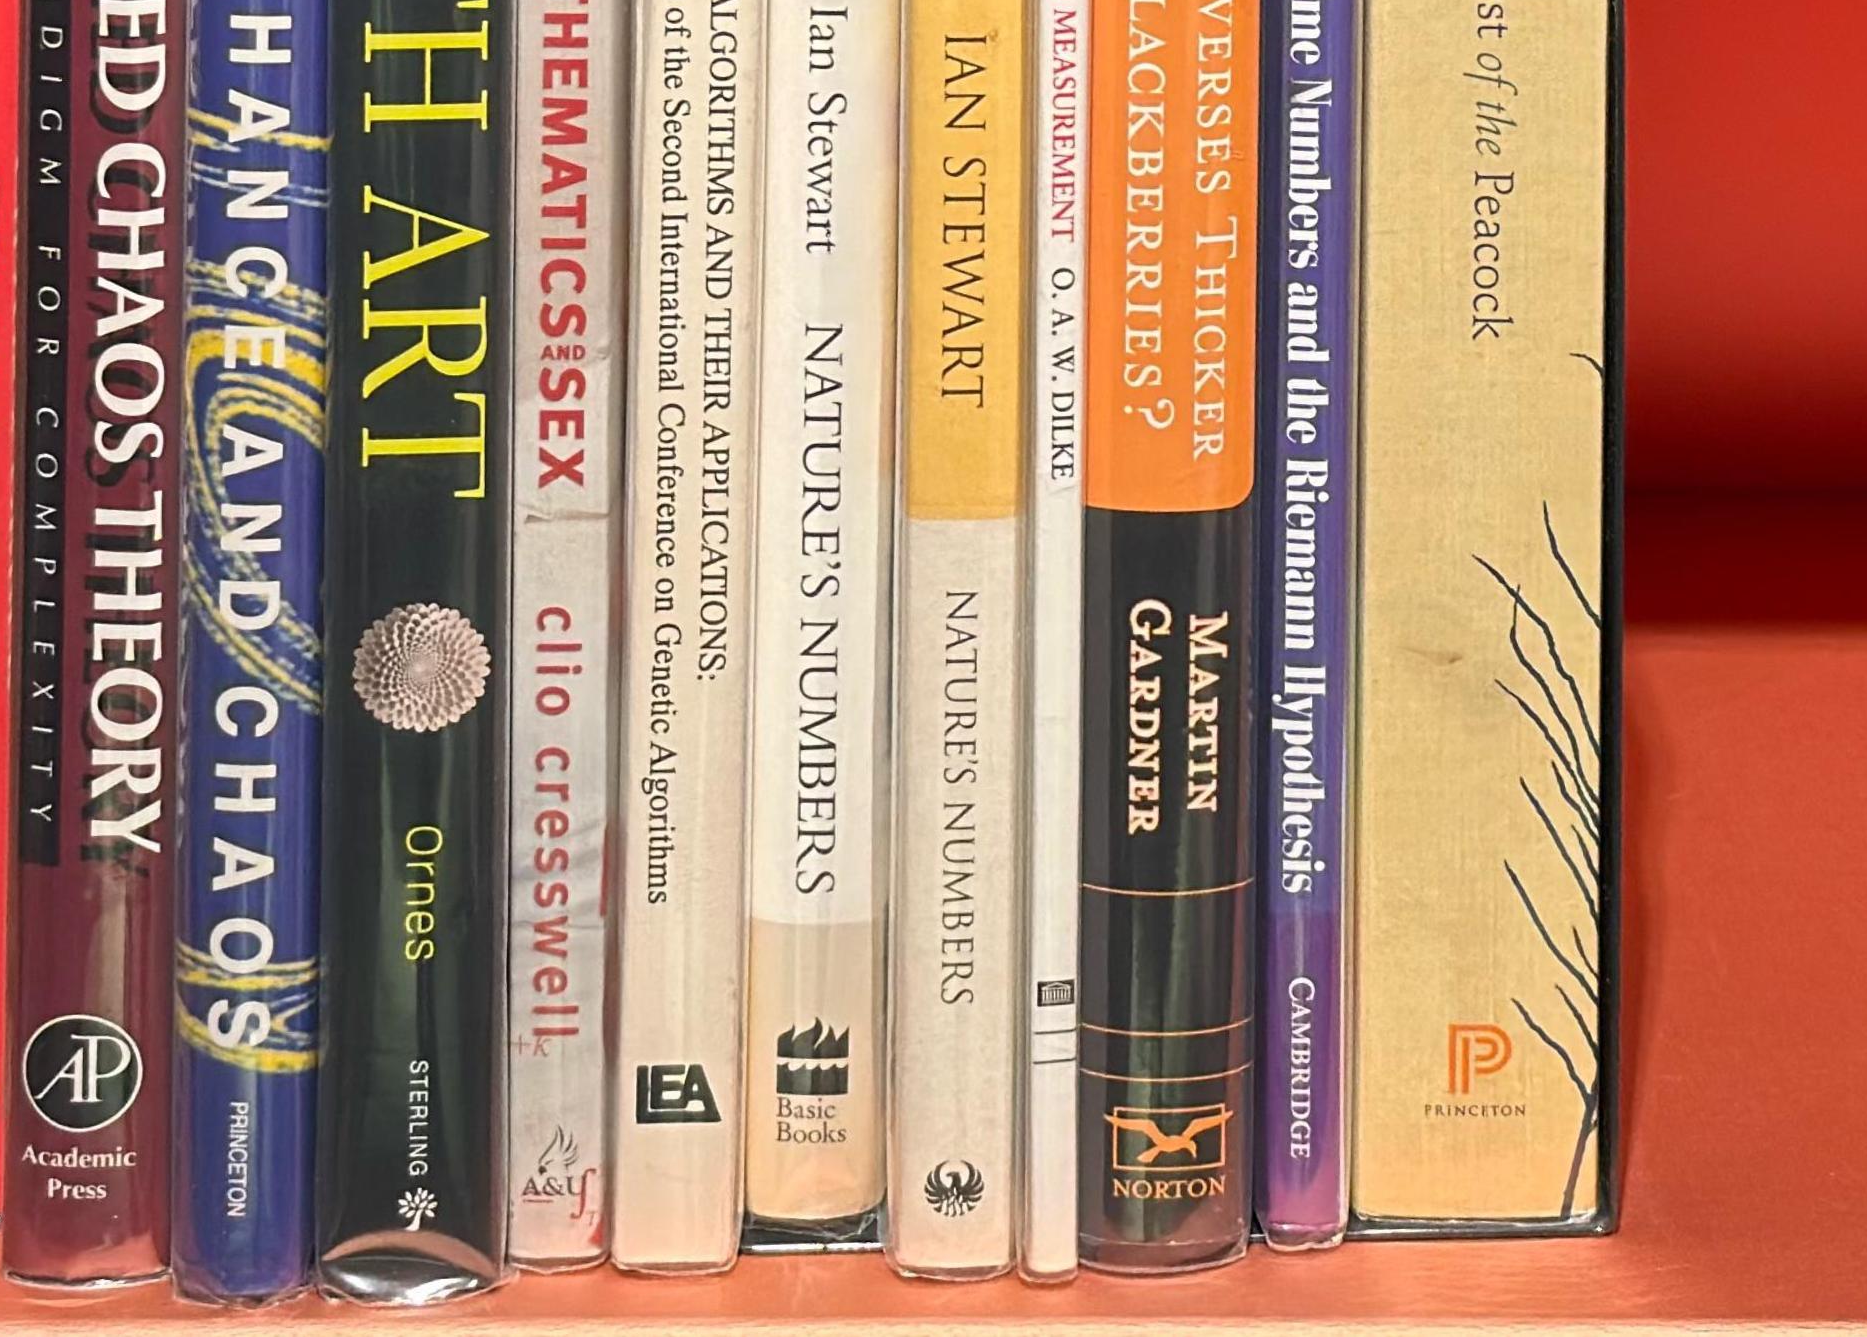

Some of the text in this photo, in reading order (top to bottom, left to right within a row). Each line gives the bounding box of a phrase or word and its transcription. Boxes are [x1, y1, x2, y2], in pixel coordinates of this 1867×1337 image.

[664, 43, 694, 91] the
[665, 10, 694, 38] of
[1464, 51, 1519, 101] of
[662, 99, 694, 201] Second
[805, 7, 848, 253] Ian Stewart
[1051, 10, 1077, 241] MEASUREMENT
[1288, 78, 1333, 269] Numbers
[1474, 99, 1518, 156] the
[704, 226, 735, 300] AND
[940, 34, 988, 410] IAN STEWART
[1471, 170, 1515, 341] Peacock
[38, 246, 60, 355] FOR
[94, 143, 166, 464] CHAOS
[362, 185, 490, 499] ART
[540, 345, 586, 360] AND
[659, 210, 690, 392] International
[703, 308, 733, 415] THEIR
[1193, 216, 1237, 459] THICKER
[1286, 281, 1330, 362] and
[539, 367, 586, 488] SEX
[1051, 391, 1076, 480] DILKE
[1284, 376, 1328, 443] the
[219, 425, 285, 631] AND
[657, 403, 687, 568] Conference
[697, 423, 732, 681] APPLICATIONS:
[30, 408, 60, 821] COMPLEXITY
[655, 576, 681, 611] on
[796, 323, 843, 895] NATURE'S NUMBERS
[1283, 460, 1330, 650] Riemann
[89, 490, 164, 853] THEORY
[651, 622, 683, 734] Genetic
[1127, 598, 1172, 834] GARDNER
[1186, 612, 1228, 812] MARTIN
[531, 606, 583, 1037] clio cresswell
[641, 742, 679, 903] Algorithms
[941, 590, 979, 1006] NATURE'S NUMBERS
[1271, 664, 1327, 893] Hypothesis
[207, 685, 281, 1048] CHAOS
[405, 826, 443, 961] Ornes
[408, 1060, 429, 1177] STERLING
[636, 1064, 721, 1123] LEA
[777, 1097, 836, 1120] Basic
[777, 1121, 847, 1143] Books
[1288, 976, 1315, 1159] CAMBRIDGE
[1425, 1104, 1527, 1117] PRINCETON
[22, 1144, 137, 1168] Academic
[48, 1179, 107, 1199] Press
[227, 1101, 249, 1217] PRINCETON
[1112, 1175, 1226, 1200] NORTON
